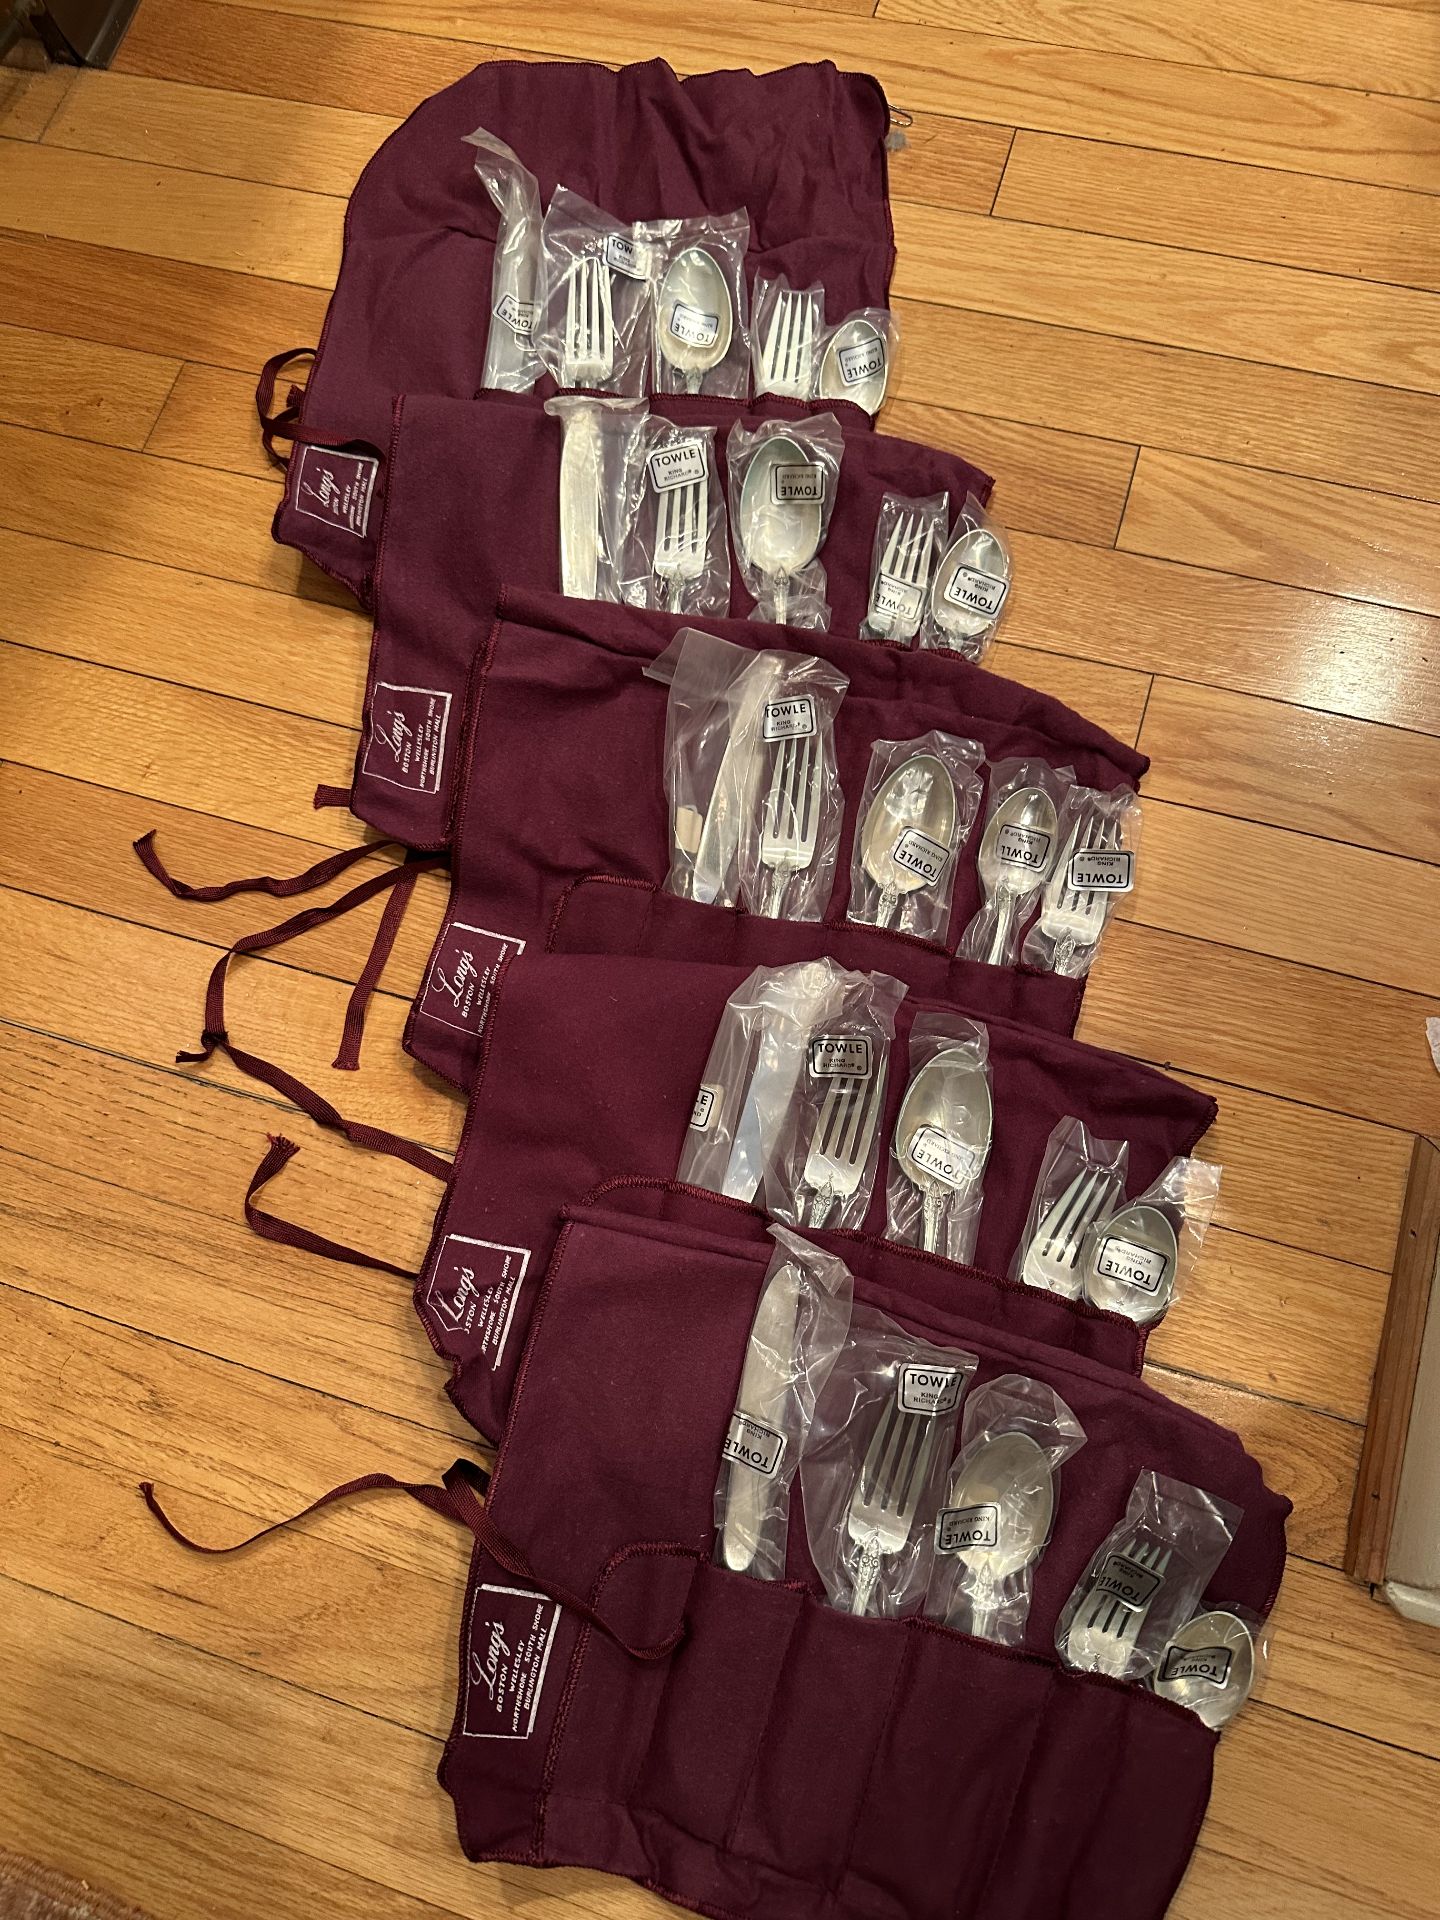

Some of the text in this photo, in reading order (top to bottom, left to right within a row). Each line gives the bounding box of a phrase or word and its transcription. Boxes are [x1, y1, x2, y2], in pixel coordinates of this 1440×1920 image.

[612, 240, 633, 255] TOW
[502, 309, 533, 329] TOWLE
[675, 323, 709, 342] TOWLE
[847, 358, 882, 378] TOWLE
[655, 450, 696, 467] TOWLE
[301, 467, 341, 507] Long's
[781, 486, 817, 496] TOWLE
[876, 593, 911, 615] TOWLE
[954, 587, 993, 610] TOWLE
[766, 703, 806, 718] TOWLE
[375, 710, 413, 763] Long's
[402, 741, 412, 774] BOSTON
[899, 850, 937, 878] TOWLE
[1077, 873, 1123, 884] TOWLE
[431, 949, 478, 1008] Long's
[490, 963, 500, 985] SOUTH
[498, 942, 508, 962] SHORE
[462, 982, 475, 1018] BOSTON
[476, 966, 491, 1006] WELLESLEY
[818, 1043, 862, 1054] TOWLE
[917, 1149, 960, 1180] TOWLE
[1105, 1260, 1151, 1285] TOWLE
[430, 1266, 480, 1323] Long's
[478, 1286, 494, 1328] WELLESLEY
[481, 1254, 512, 1354] RTHSHORE SOUTH SHORE
[464, 1301, 477, 1334] STON
[492, 1276, 516, 1346] BURLINGTON MALL
[910, 1374, 957, 1388] TOWLE
[747, 1428, 762, 1439] KING
[724, 1438, 768, 1468] TOWLE
[945, 1530, 991, 1545] TOWLE
[1100, 1576, 1140, 1600] TOWLE
[470, 1621, 511, 1700] Long's
[508, 1639, 525, 1692] WELLESLEY
[512, 1603, 544, 1732] NORTHSHORE SOUTH SHORE
[523, 1627, 547, 1710] BURLINGTON MALL
[1172, 1664, 1217, 1676] TOWLE
[496, 1663, 509, 1713] BOSTON
